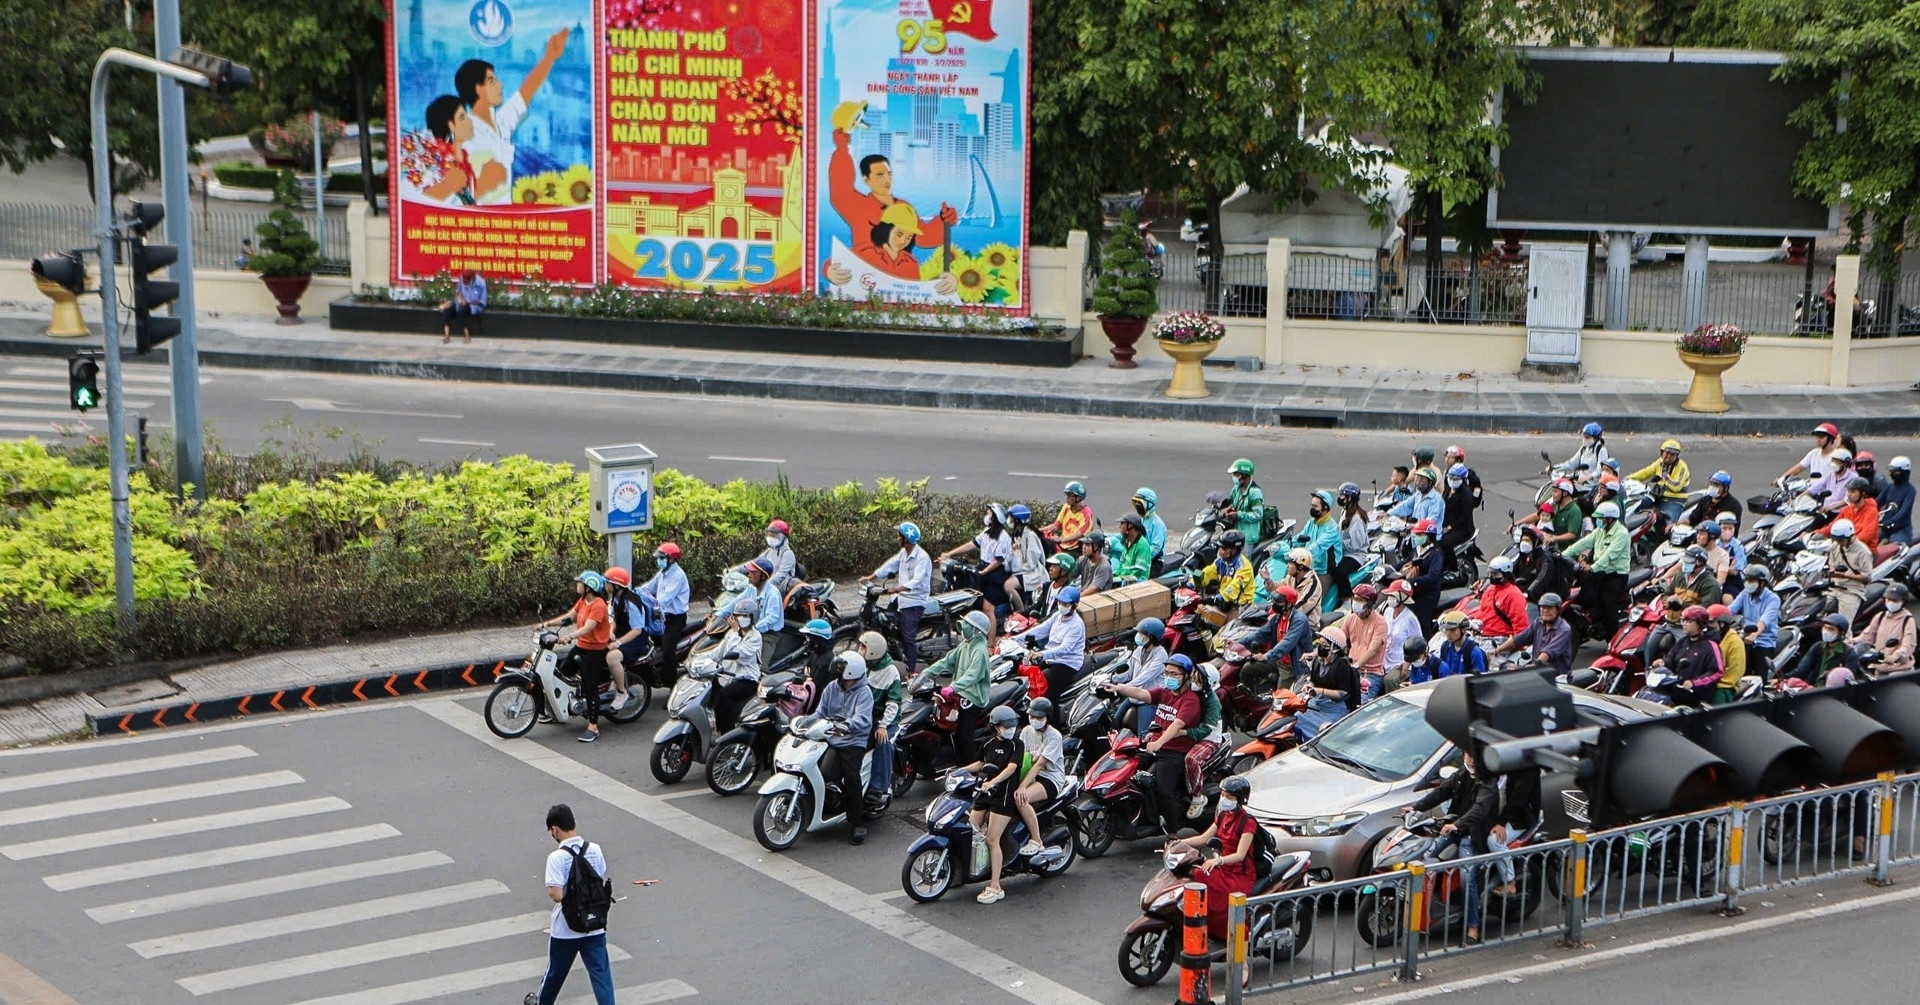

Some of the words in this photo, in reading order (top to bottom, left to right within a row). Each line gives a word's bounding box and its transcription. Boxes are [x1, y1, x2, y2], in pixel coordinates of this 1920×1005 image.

[609, 27, 678, 50] THÀNH
[683, 27, 727, 51] PHỐ
[897, 19, 948, 54] 95
[610, 49, 639, 74] HỒ
[644, 53, 680, 75] CHÍ
[686, 56, 743, 78] MINH
[610, 75, 655, 97] HÂN
[660, 79, 718, 100] HOAN
[958, 87, 979, 97] NAM
[610, 98, 667, 120] CHÀO
[672, 100, 717, 123] ĐÓN
[611, 120, 661, 144] NĂM
[666, 123, 708, 146] MỚI
[633, 238, 777, 285] 2025
